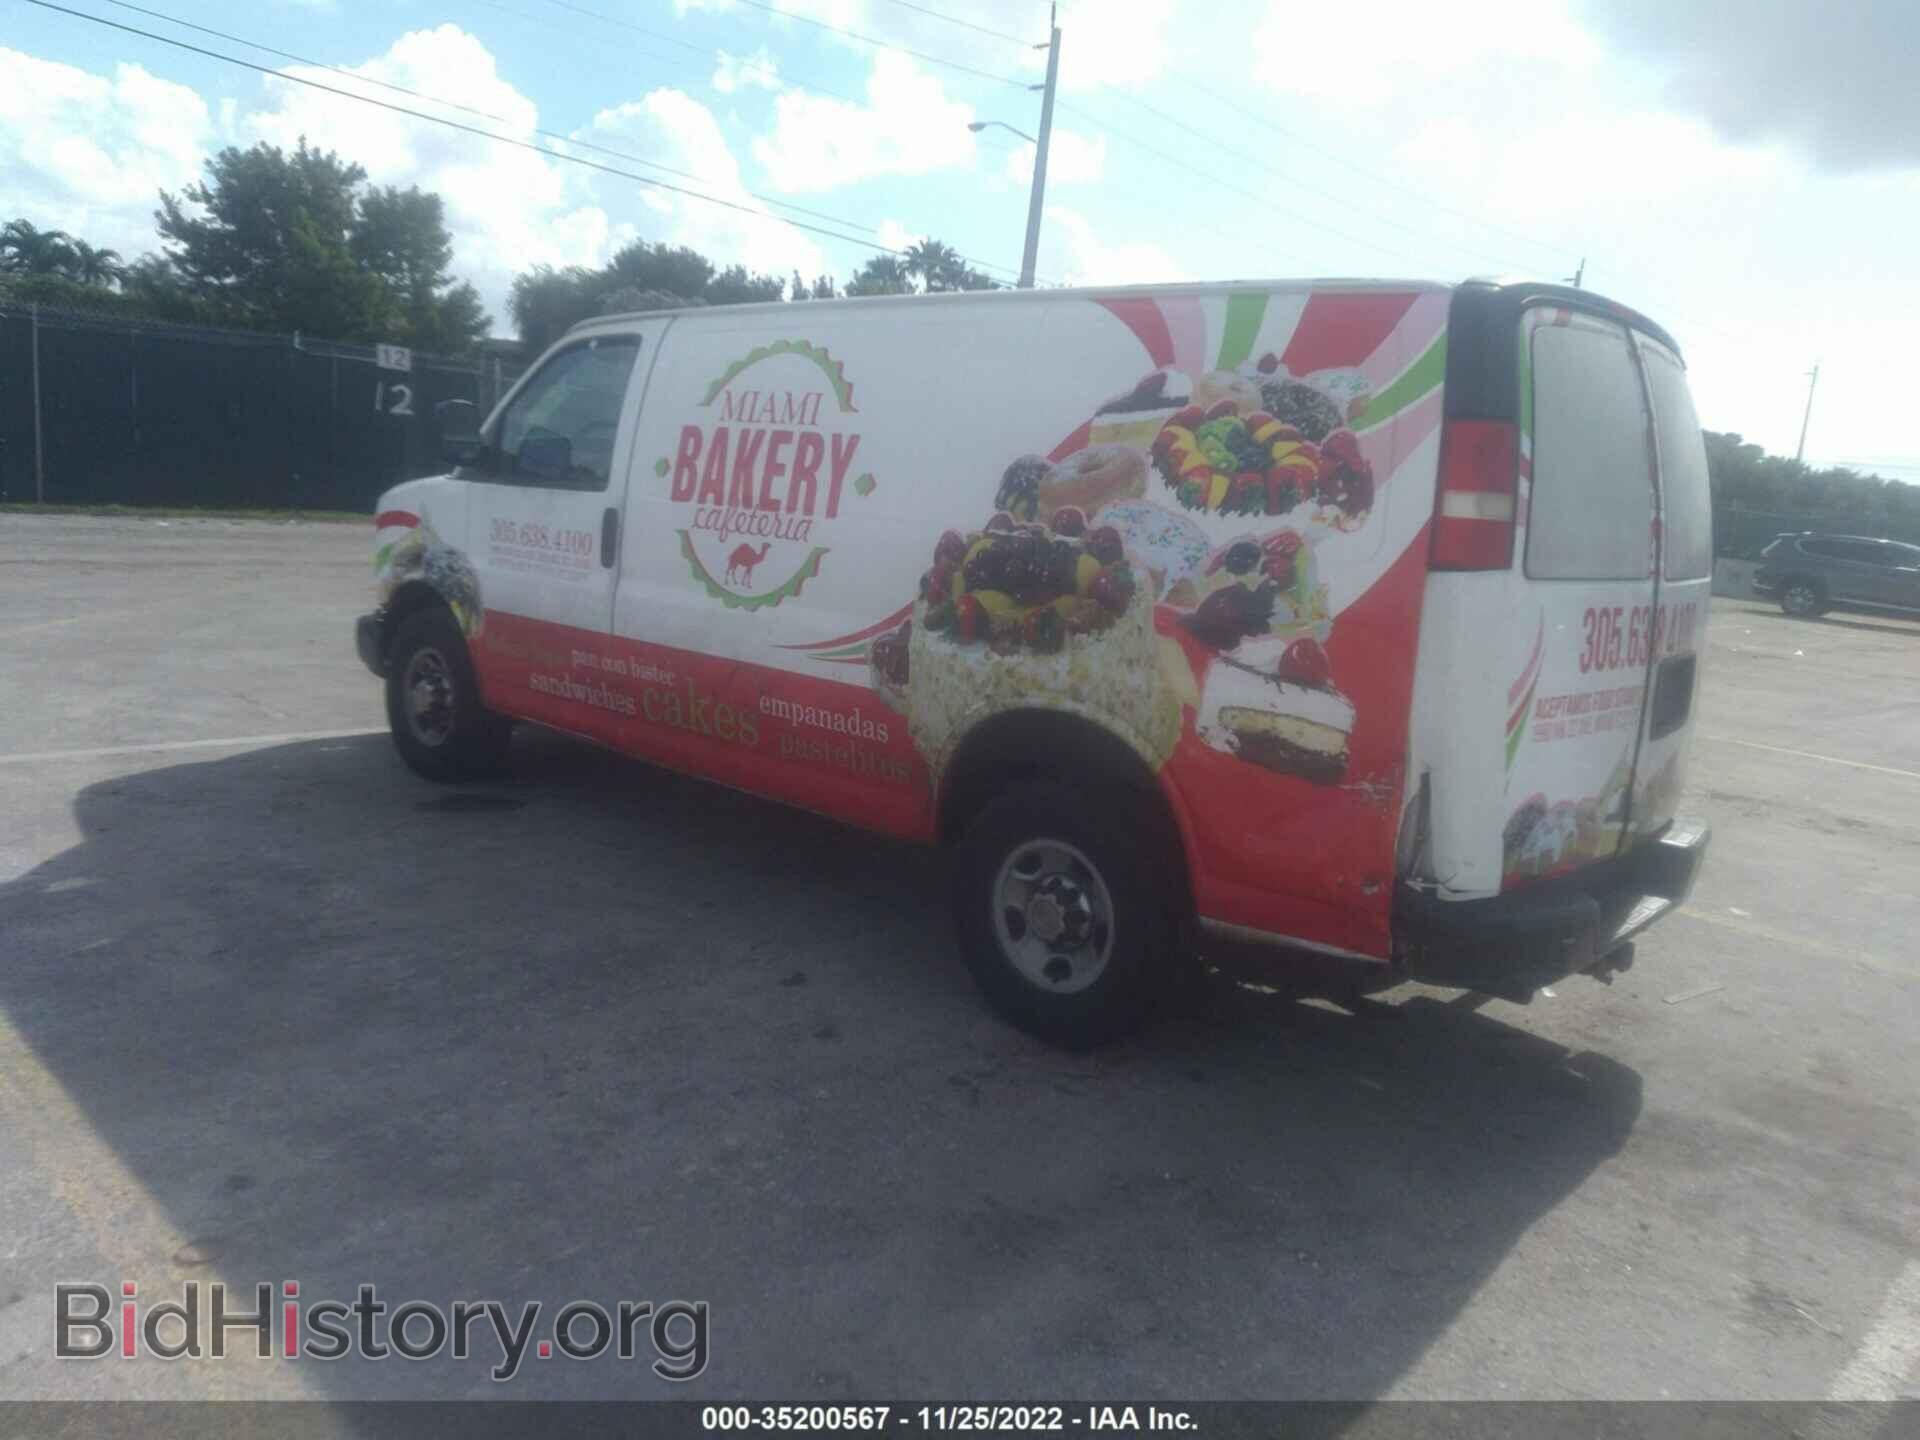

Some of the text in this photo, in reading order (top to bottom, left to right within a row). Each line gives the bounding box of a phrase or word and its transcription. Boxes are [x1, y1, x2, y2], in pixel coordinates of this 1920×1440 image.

[383, 348, 406, 368] 12
[375, 381, 415, 415] 12
[719, 390, 825, 425] MIAMI
[671, 424, 861, 520] BAKERY
[691, 503, 814, 543] cafeteria
[529, 672, 636, 716] sandwiches
[643, 677, 760, 747] cakes
[759, 694, 889, 744] empanadas
